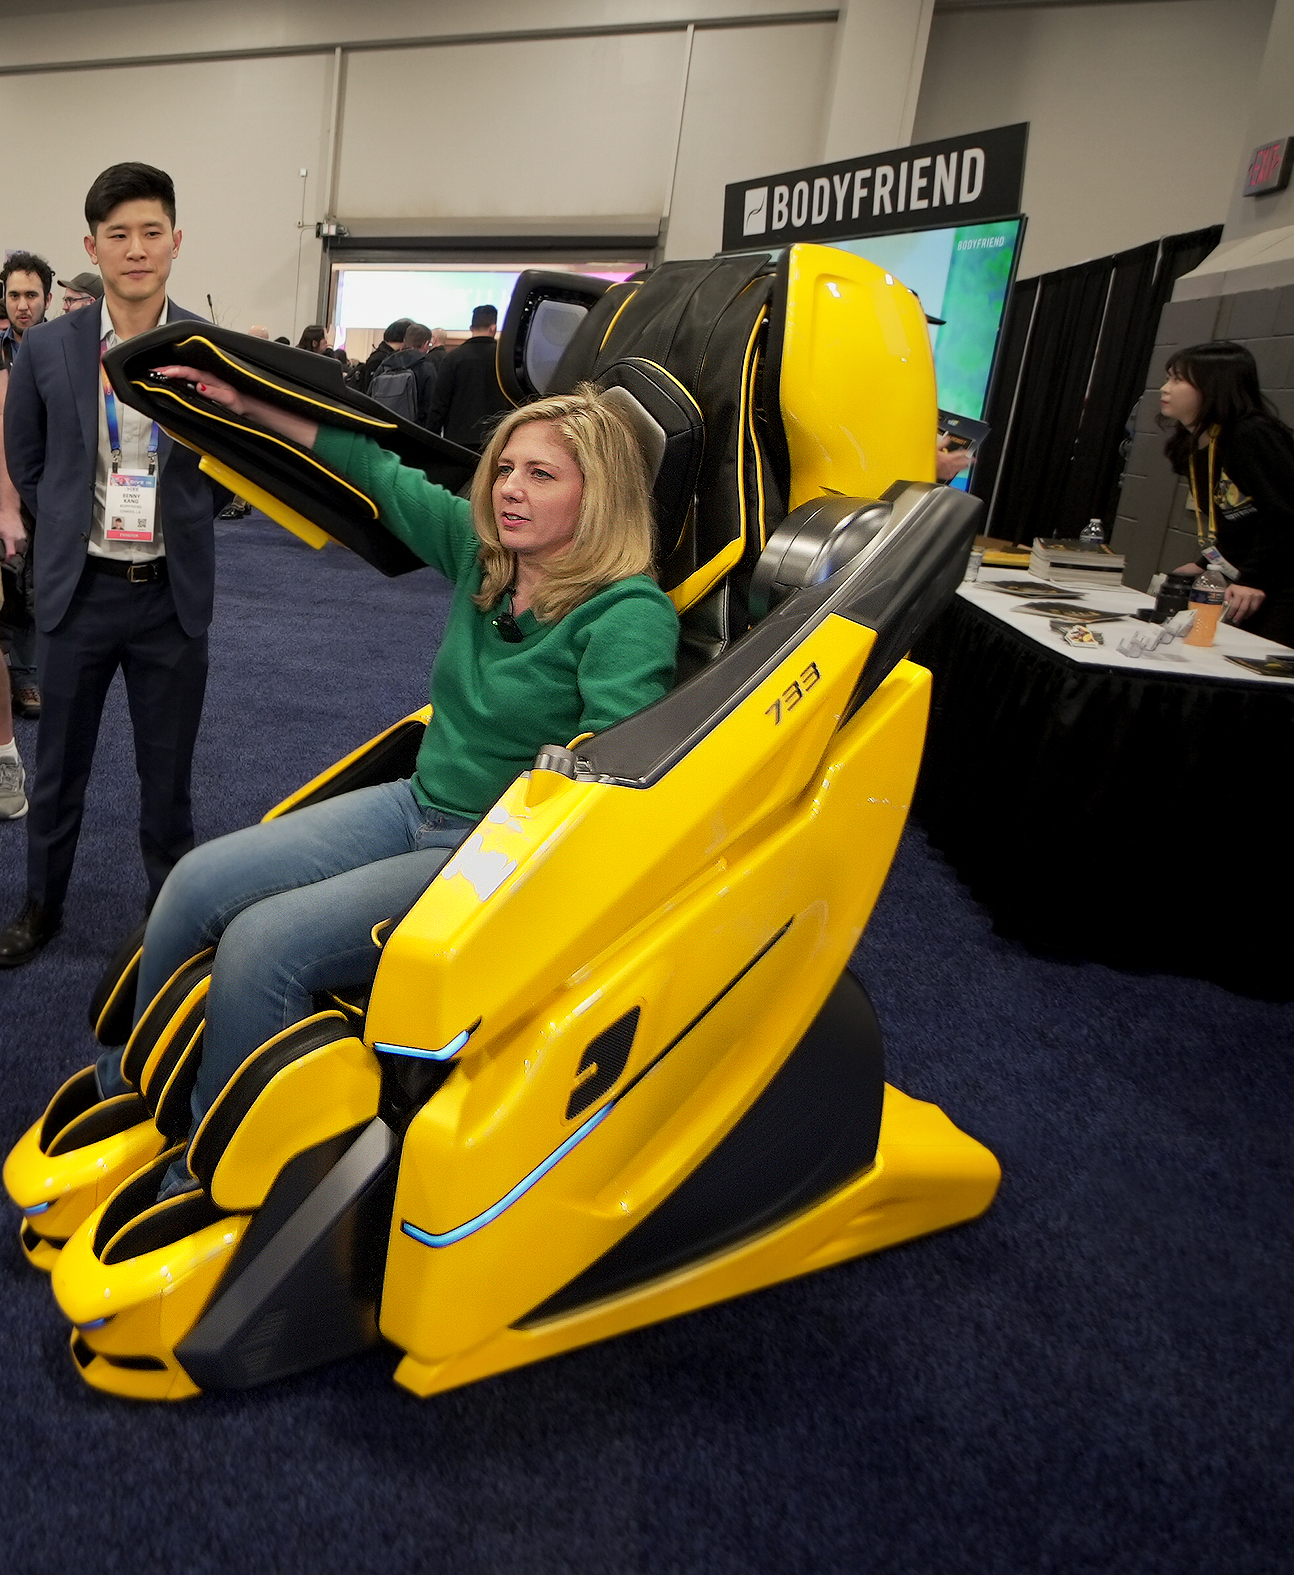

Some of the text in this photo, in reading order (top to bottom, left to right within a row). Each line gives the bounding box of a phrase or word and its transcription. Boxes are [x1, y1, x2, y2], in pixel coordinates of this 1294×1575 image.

[771, 147, 986, 231] BODYFRIEND
[1250, 144, 1280, 186] EXIT
[957, 236, 1005, 251] BODYFRIEND
[765, 661, 820, 726] 733
